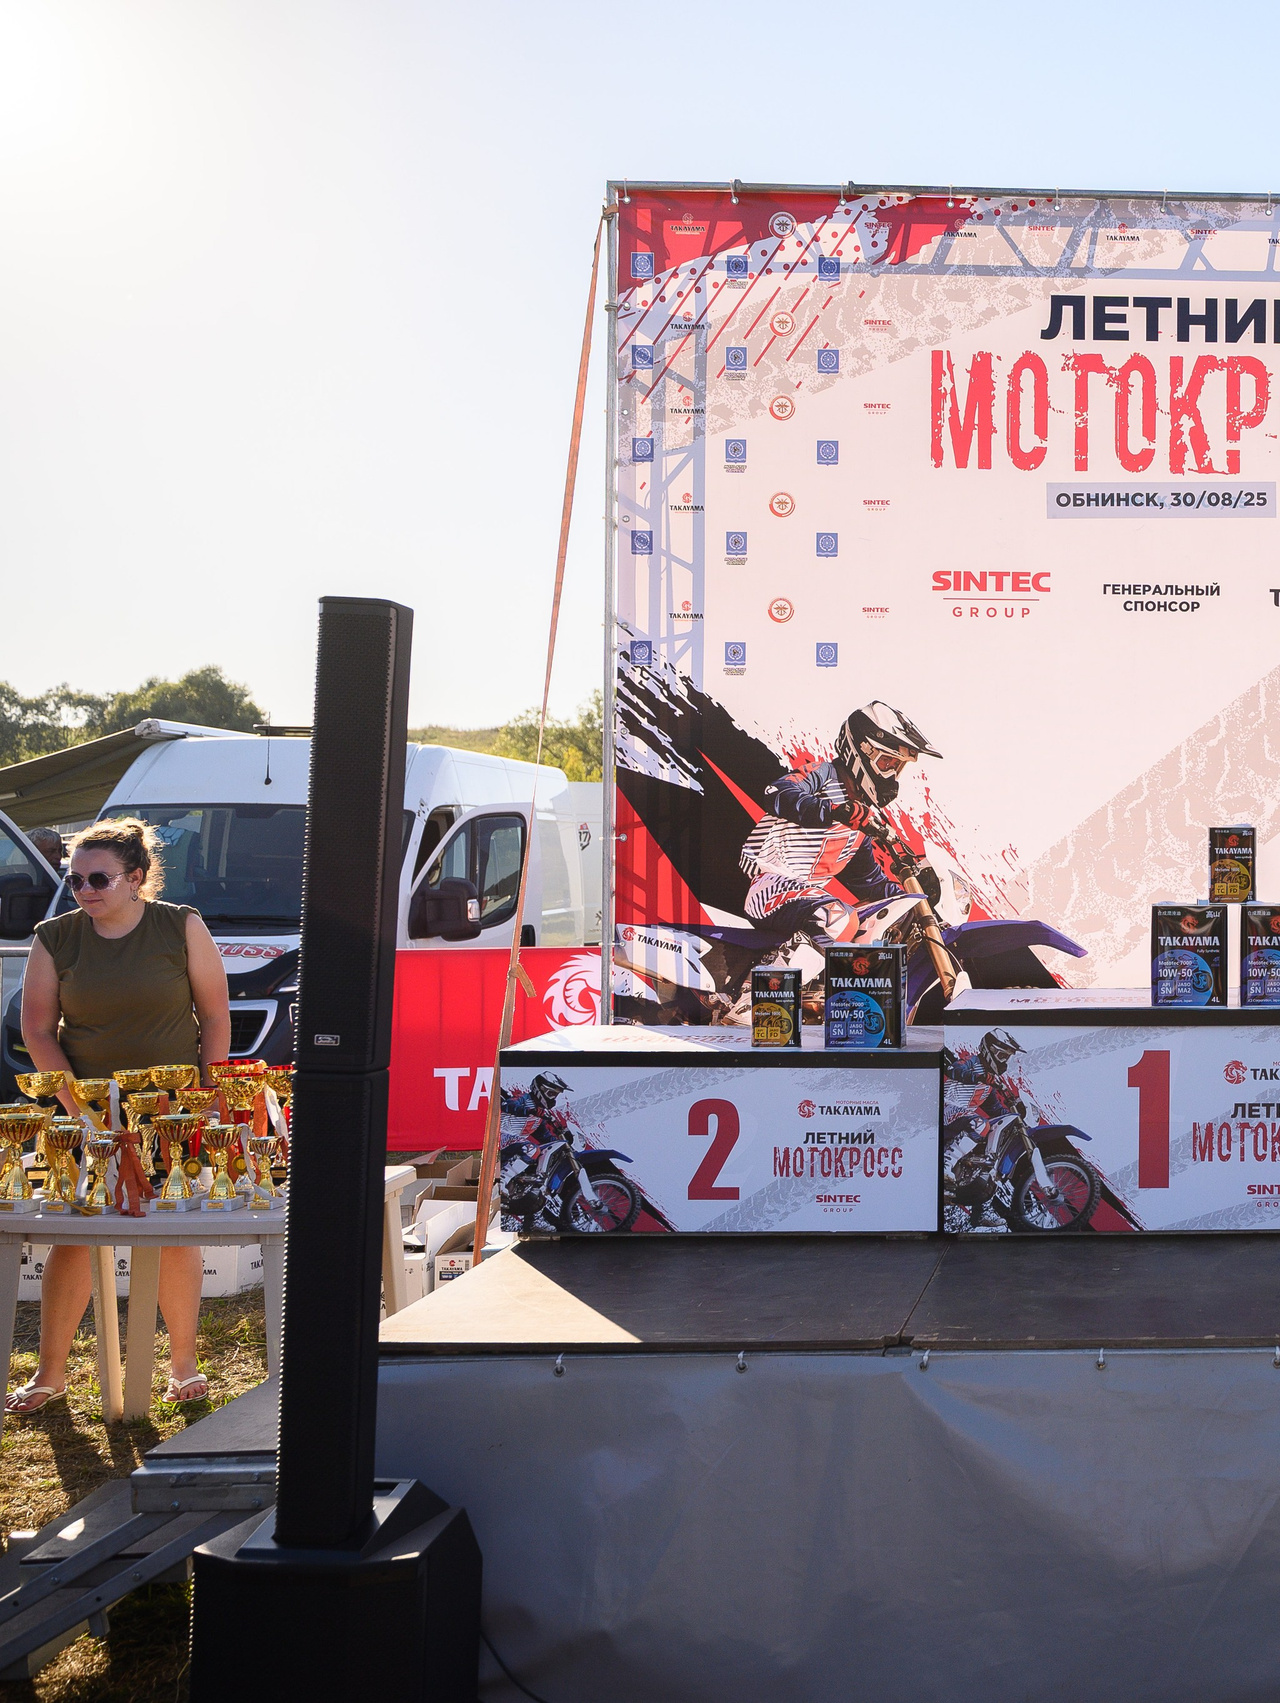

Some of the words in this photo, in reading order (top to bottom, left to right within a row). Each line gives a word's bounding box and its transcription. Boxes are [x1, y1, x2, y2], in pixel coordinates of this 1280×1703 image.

[1055, 491, 1164, 510] ОБНИНСК,
[1170, 490, 1268, 510] 30/08/25
[931, 570, 1051, 593] SINTEC
[1103, 582, 1221, 596] ГЕНЕРАЛЬНЫЙ
[952, 606, 1032, 619] GROUP
[1123, 600, 1200, 612] СПОНСОР
[638, 934, 682, 954] TAKAYAMA
[1158, 936, 1220, 946] TAKAYAMA
[1158, 968, 1192, 977] 10W-50
[830, 978, 892, 988] TAKAYAMA
[830, 1010, 864, 1018] 10W-50
[819, 1106, 881, 1115] TAKAYAMA
[1127, 1050, 1170, 1188] 1
[803, 1130, 875, 1144] ЛЕТНИЙ
[687, 1098, 740, 1200] 2
[773, 1147, 903, 1178] МОТОКРОСС
[816, 1195, 861, 1203] SINTEC
